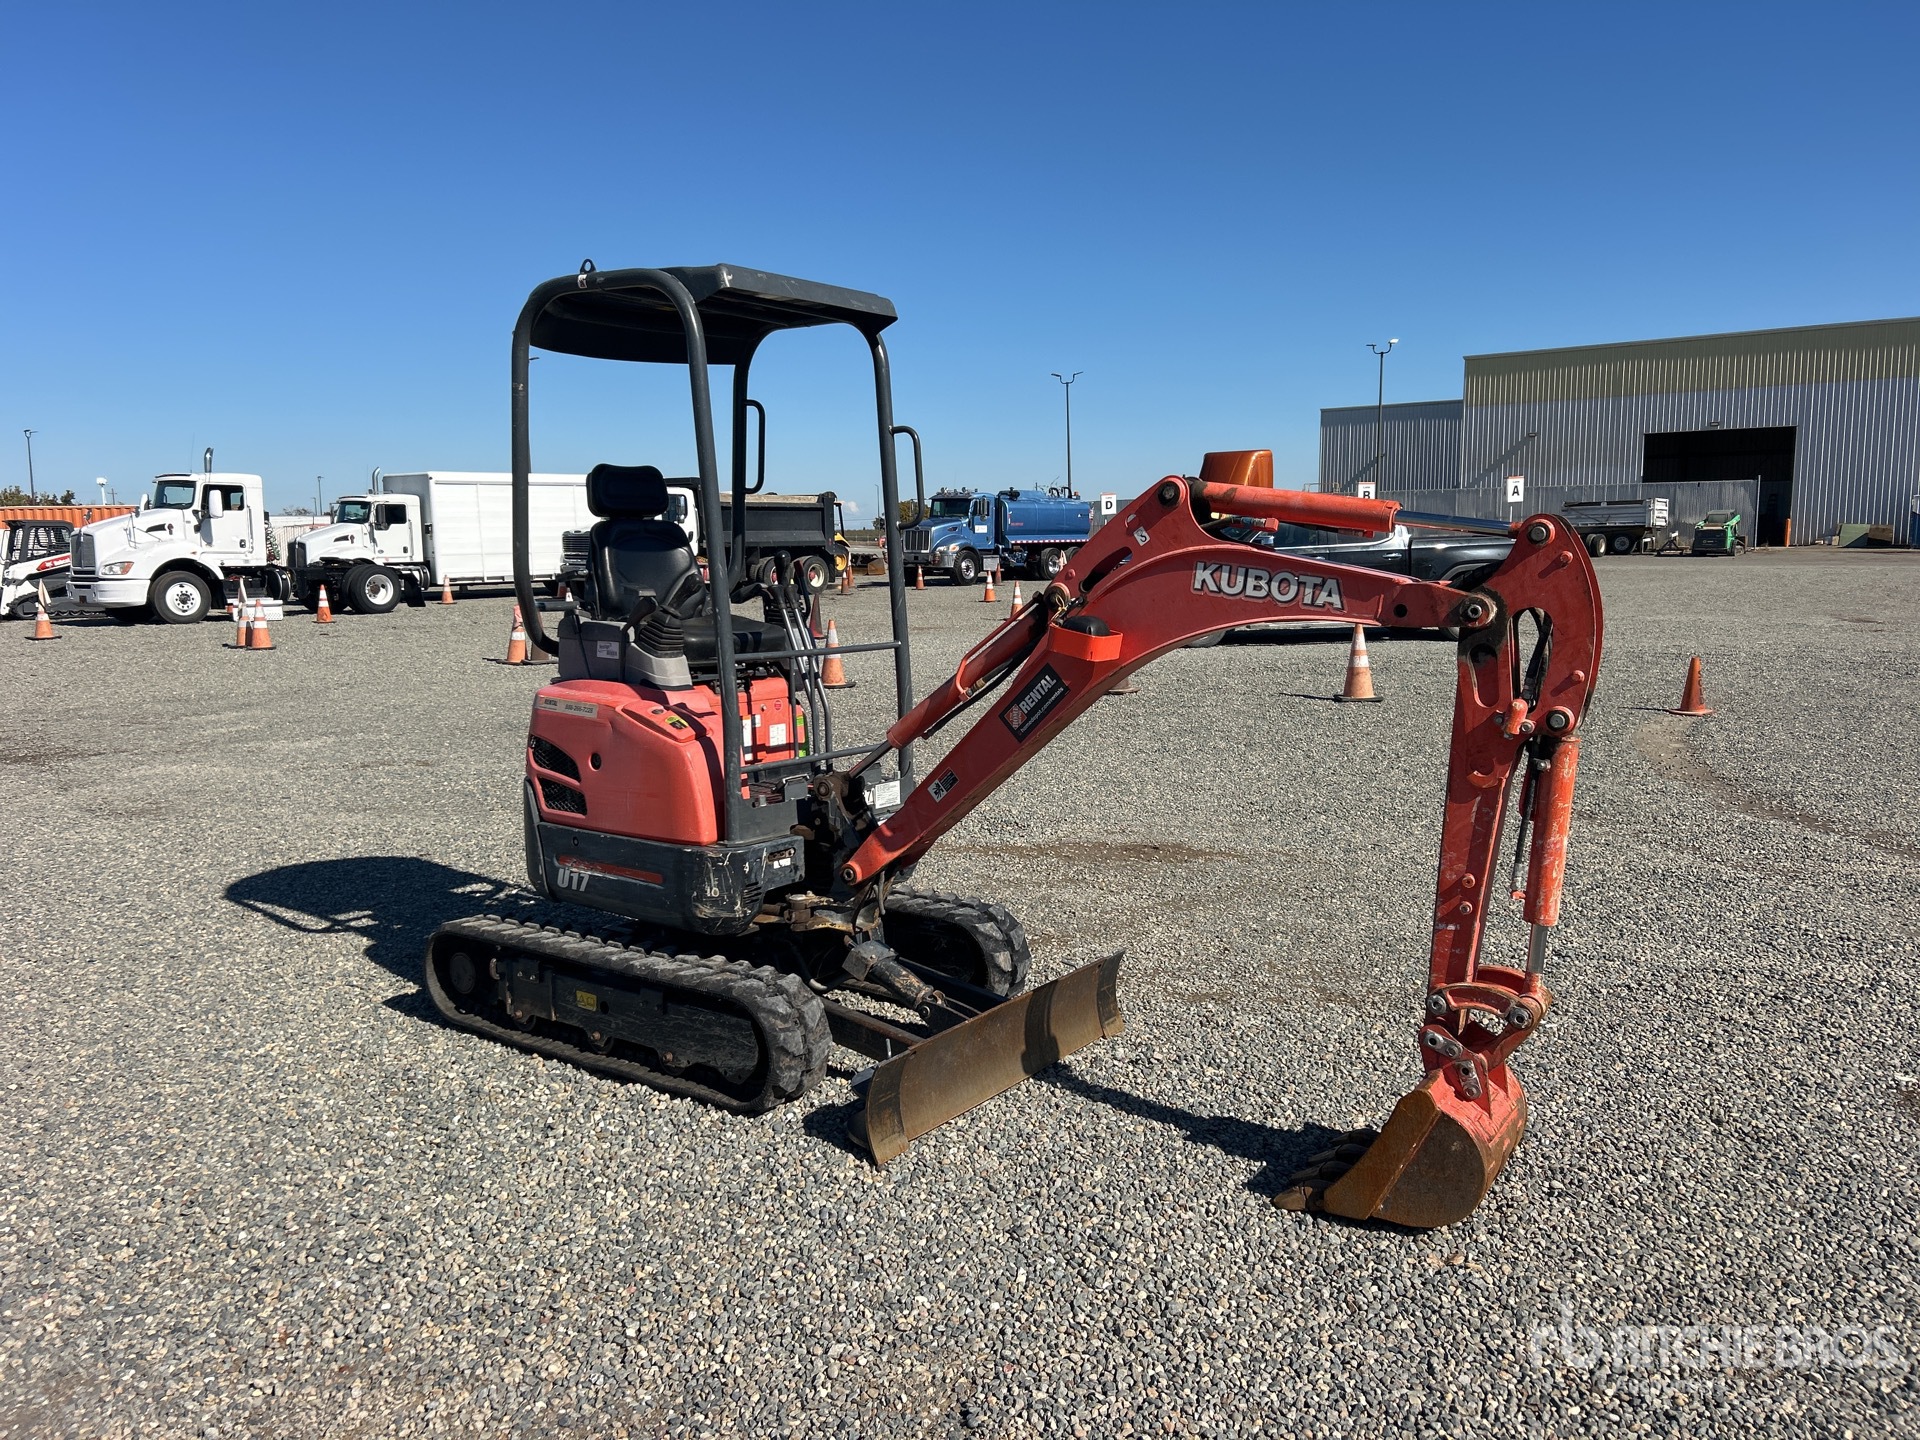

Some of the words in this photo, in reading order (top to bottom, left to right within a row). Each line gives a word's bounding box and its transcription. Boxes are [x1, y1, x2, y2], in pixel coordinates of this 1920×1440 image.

[1511, 485, 1520, 496] A
[1105, 500, 1113, 510] D
[1192, 561, 1345, 611] KUBOTA
[1019, 675, 1057, 714] RENTAL
[557, 867, 590, 892] U17
